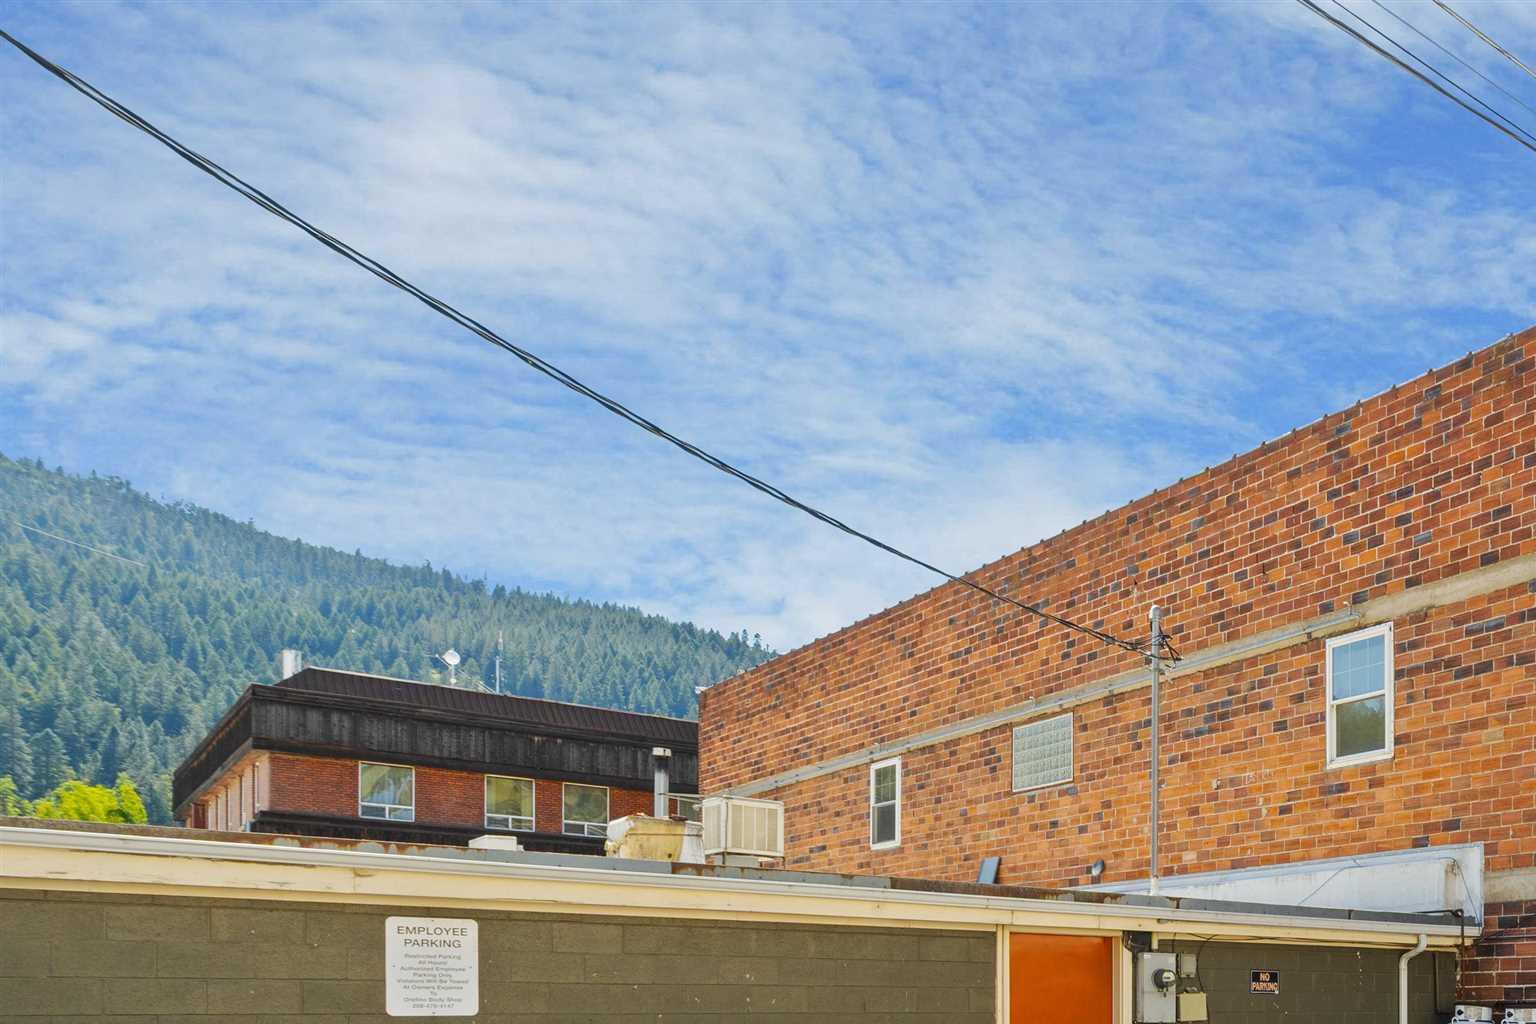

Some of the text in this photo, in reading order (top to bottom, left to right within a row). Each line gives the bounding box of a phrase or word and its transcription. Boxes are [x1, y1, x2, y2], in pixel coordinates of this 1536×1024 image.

[397, 926, 468, 936] EMPLOYEE
[404, 938, 462, 948] PARKING
[1260, 972, 1270, 981] NO
[1252, 982, 1279, 991] PARKING
